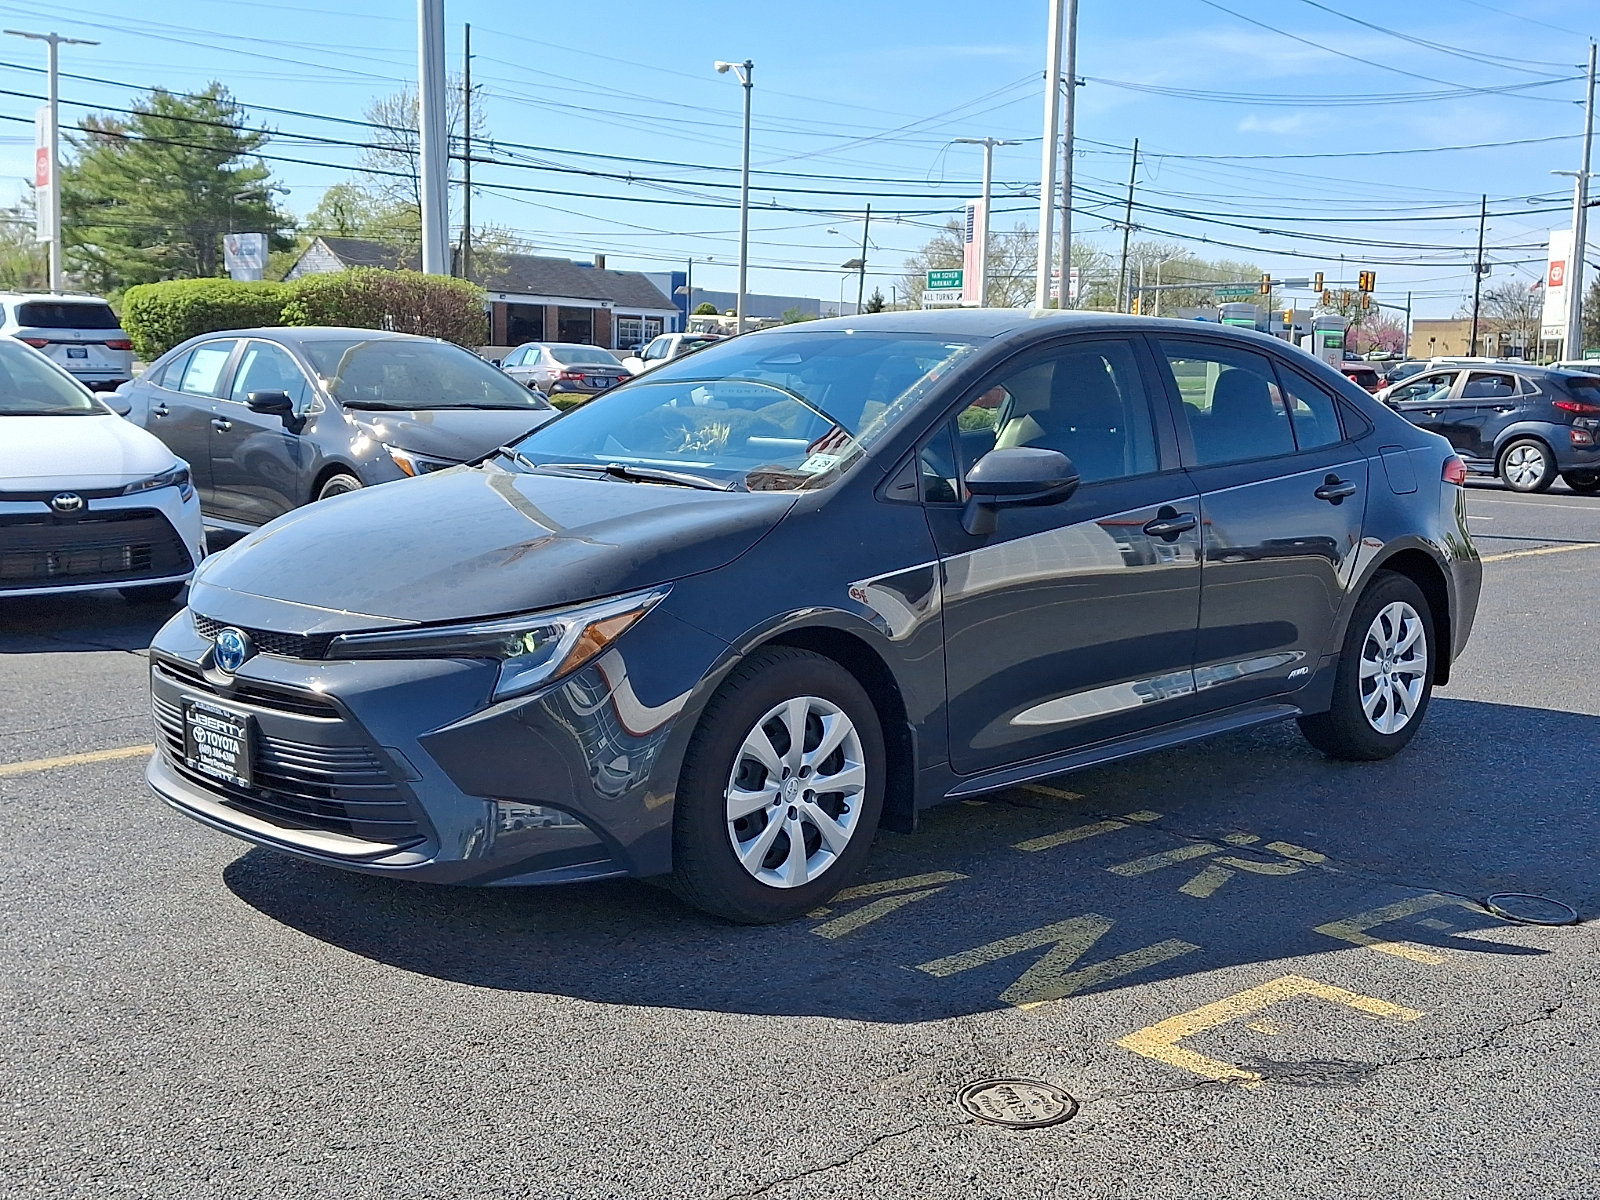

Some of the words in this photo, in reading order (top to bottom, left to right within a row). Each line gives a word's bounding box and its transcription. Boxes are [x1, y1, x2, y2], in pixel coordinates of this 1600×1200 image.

[924, 293, 934, 301] ALL
[936, 293, 954, 301] TURNS
[1543, 328, 1563, 336] AHEAD
[186, 710, 246, 738] LIBERTY
[205, 731, 241, 755] TOYOTA
